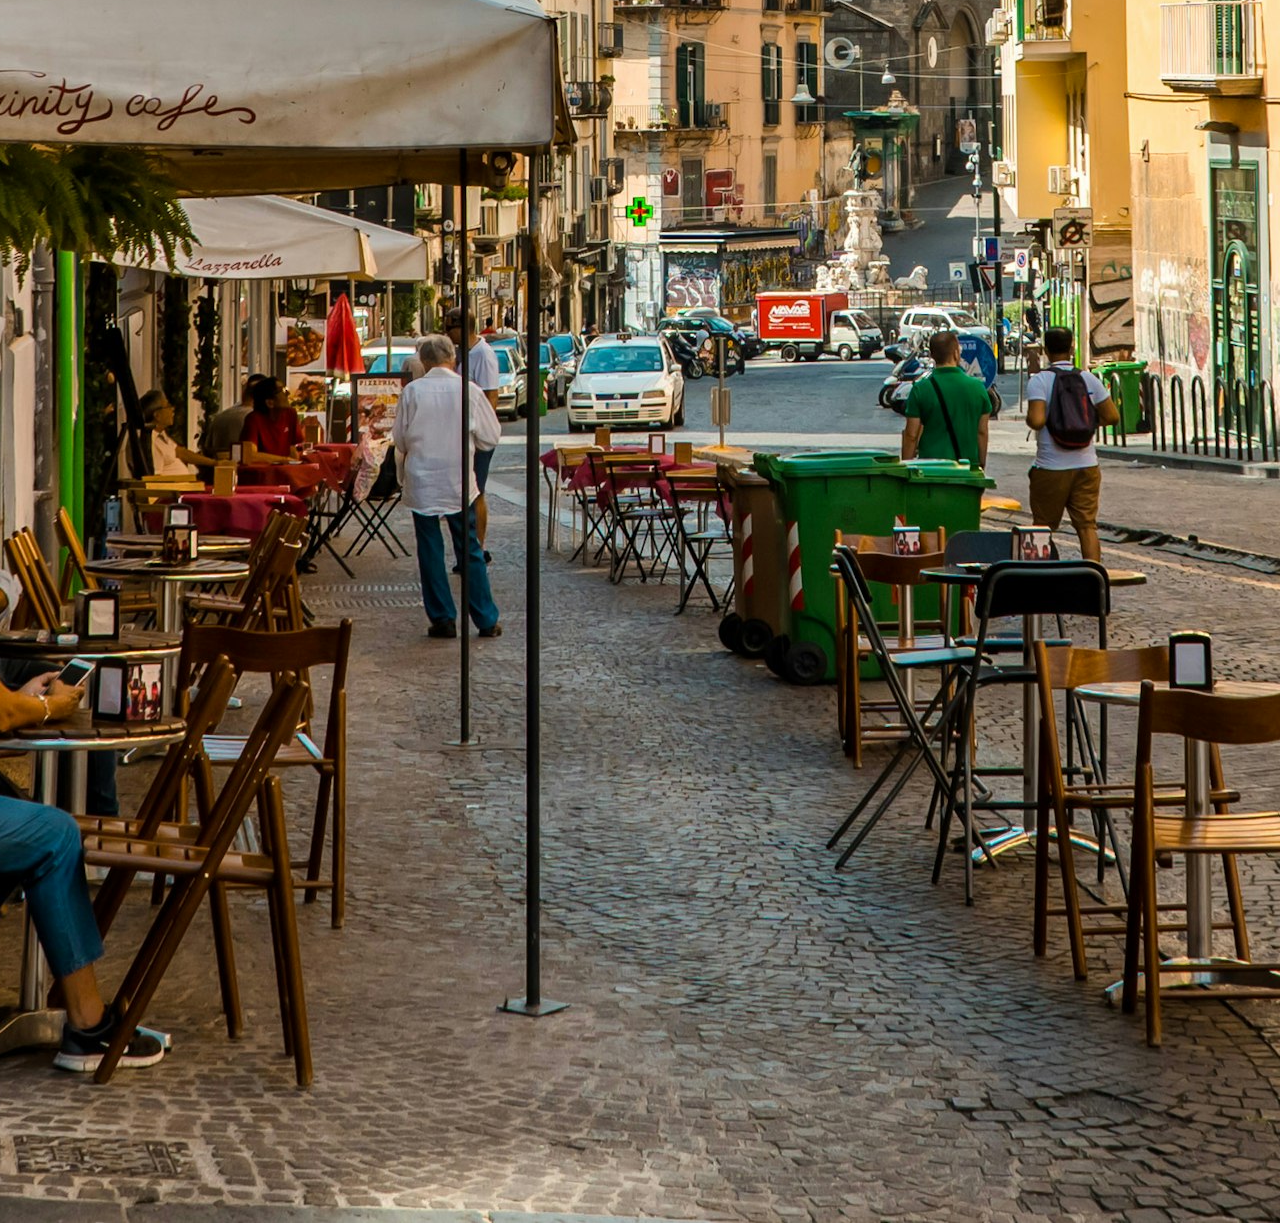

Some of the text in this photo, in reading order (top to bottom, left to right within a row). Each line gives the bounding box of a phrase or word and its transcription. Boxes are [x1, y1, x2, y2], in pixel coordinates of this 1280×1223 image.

[124, 83, 256, 131] cafe
[185, 252, 283, 275] Lazzarella
[769, 303, 811, 316] NAVAS
[359, 379, 397, 388] PIZZERIA
